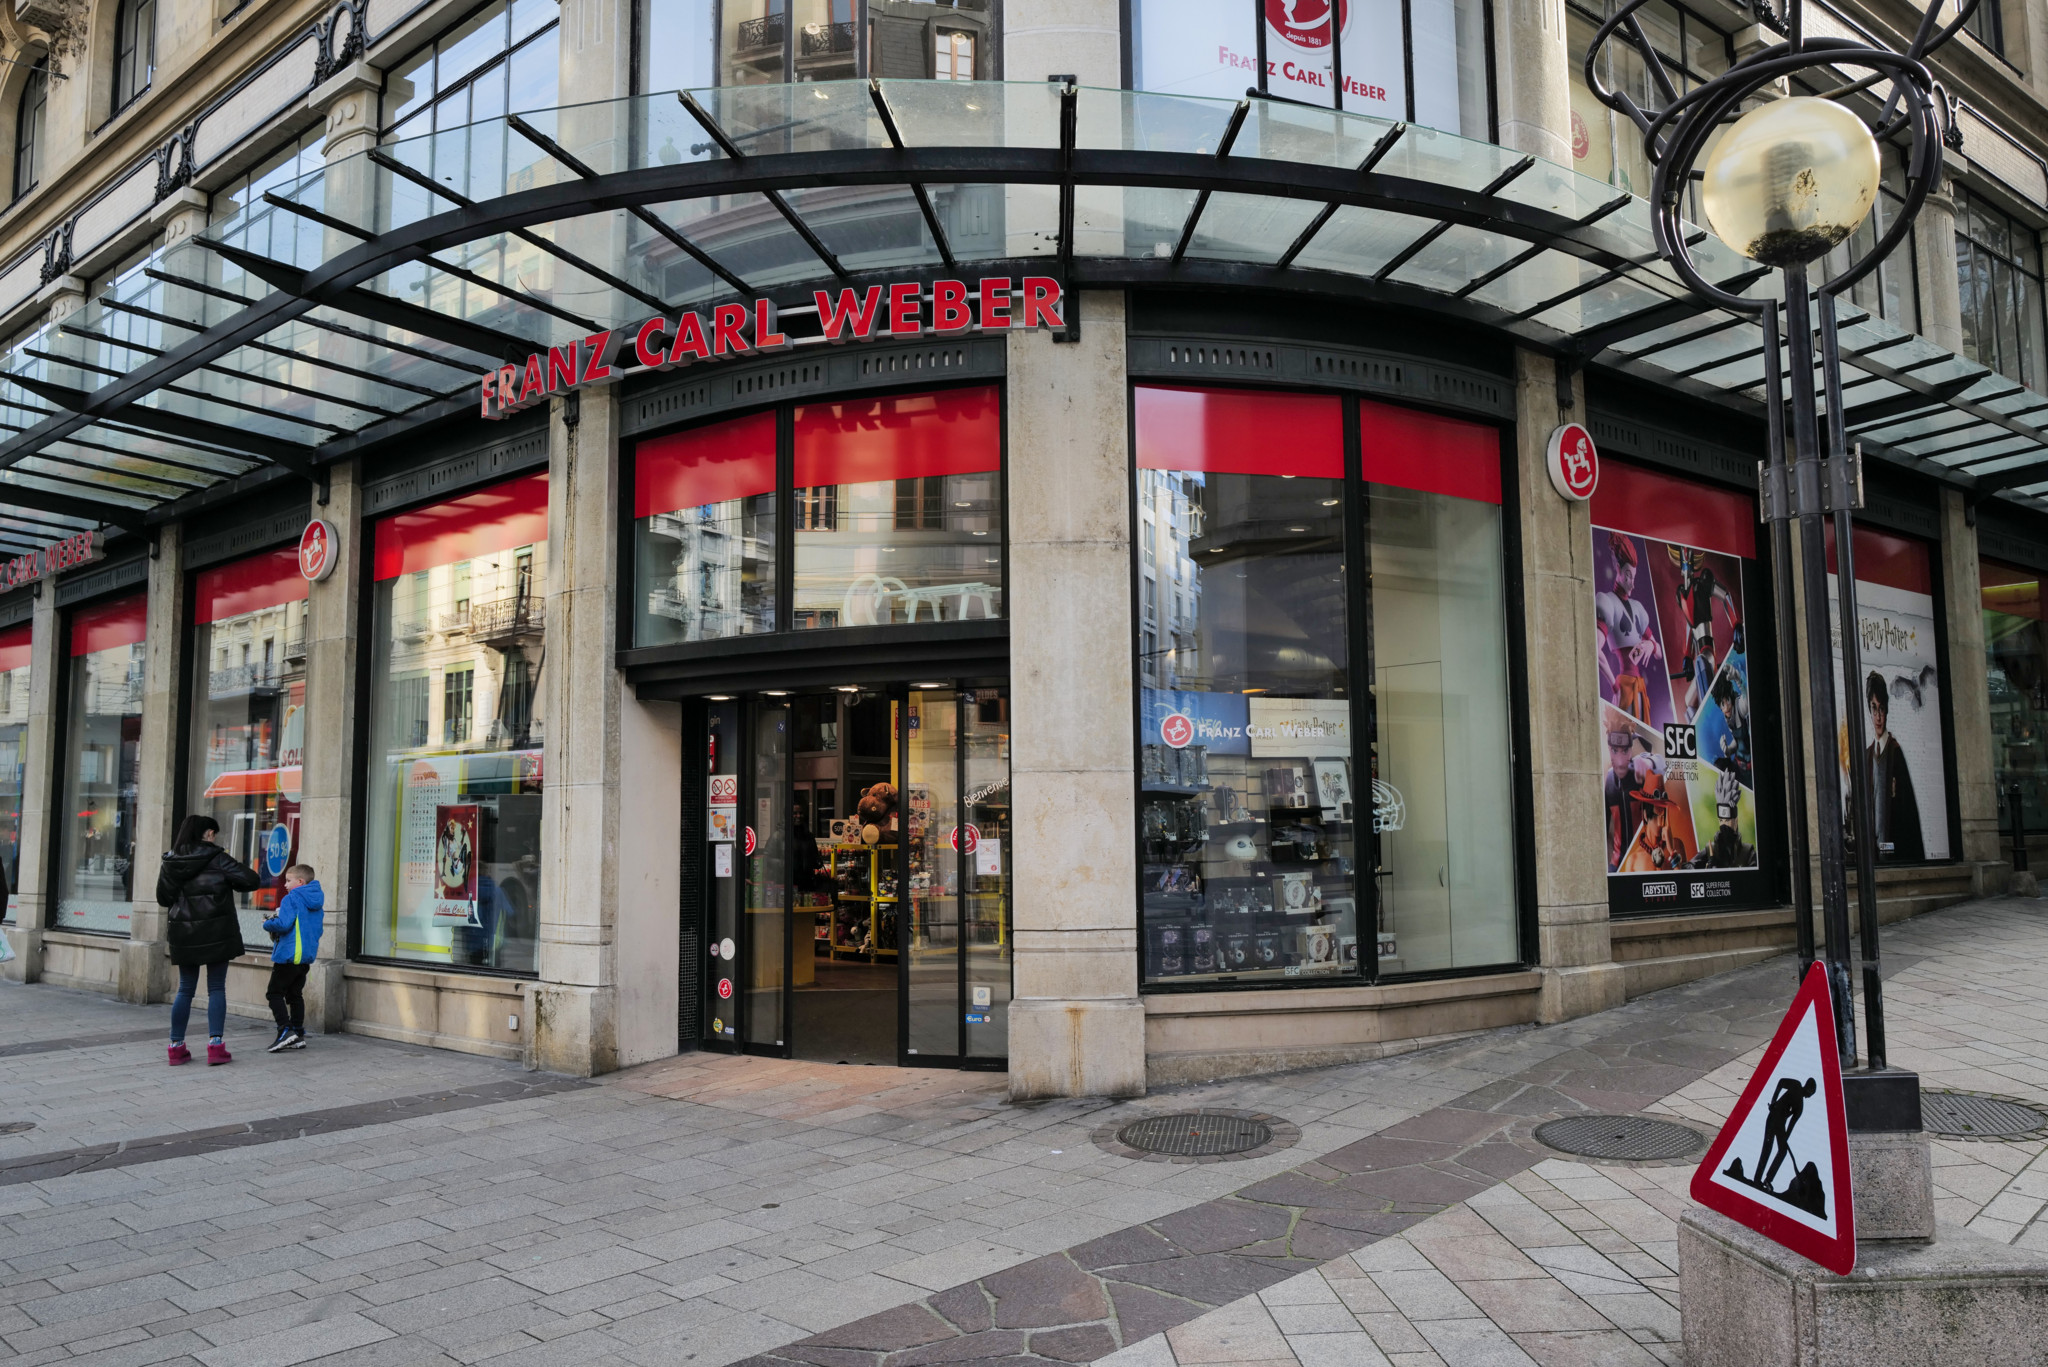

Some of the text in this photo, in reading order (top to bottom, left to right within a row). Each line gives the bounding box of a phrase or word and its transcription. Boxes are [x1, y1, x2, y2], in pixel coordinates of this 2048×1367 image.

[1286, 31, 1322, 46] depuis 1881
[1219, 46, 1276, 76] FRAZ
[1283, 62, 1325, 87] CARL
[481, 276, 1066, 420] FRANZ CARL WEBER
[7, 551, 40, 586] CARL
[45, 530, 93, 574] WEBER
[1861, 617, 1884, 652] Harry
[1884, 617, 1908, 657] Potter
[1198, 724, 1241, 738] FRANZ
[1245, 724, 1278, 738] CARL
[1280, 724, 1325, 738] WEBER
[1666, 726, 1696, 757] SFC
[1665, 760, 1698, 770] SUPER FIGURE
[1666, 771, 1699, 781] COLLECTION
[963, 777, 1009, 808] Bienvenue
[909, 800, 929, 808] OLDES
[270, 843, 279, 859] 50
[1645, 884, 1676, 895] ABYSTYLE
[1692, 884, 1704, 896] SFC
[1706, 881, 1718, 889] SUPER
[1706, 889, 1732, 898] COLLECTION
[1286, 966, 1298, 975] SFC
